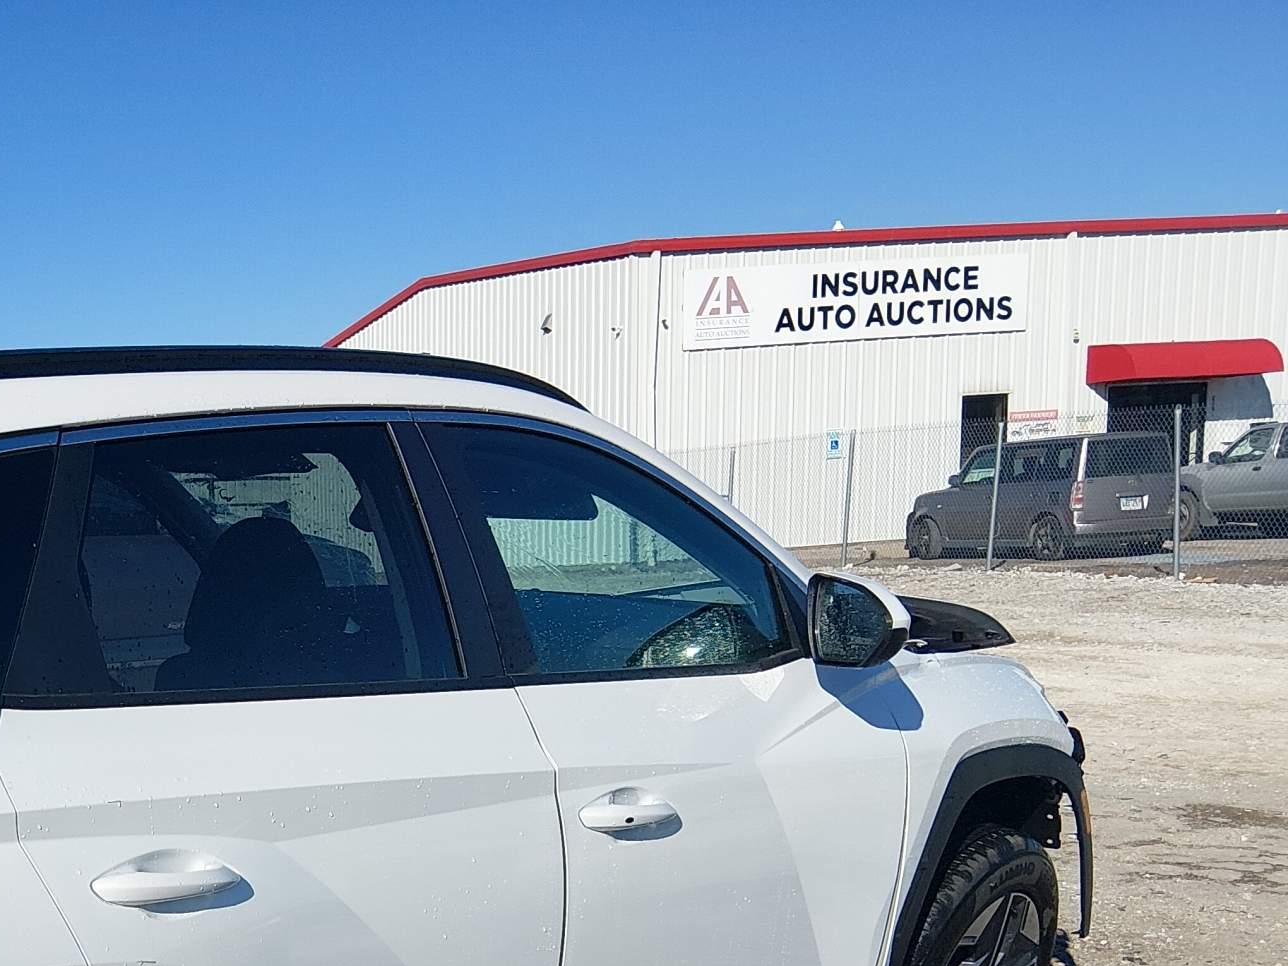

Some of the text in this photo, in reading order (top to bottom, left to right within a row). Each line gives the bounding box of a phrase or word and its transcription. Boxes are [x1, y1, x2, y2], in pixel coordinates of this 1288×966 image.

[812, 266, 979, 298] INSURANCE
[695, 318, 749, 328] INSURANCE
[774, 296, 1013, 333] AUTO AUCTIONS
